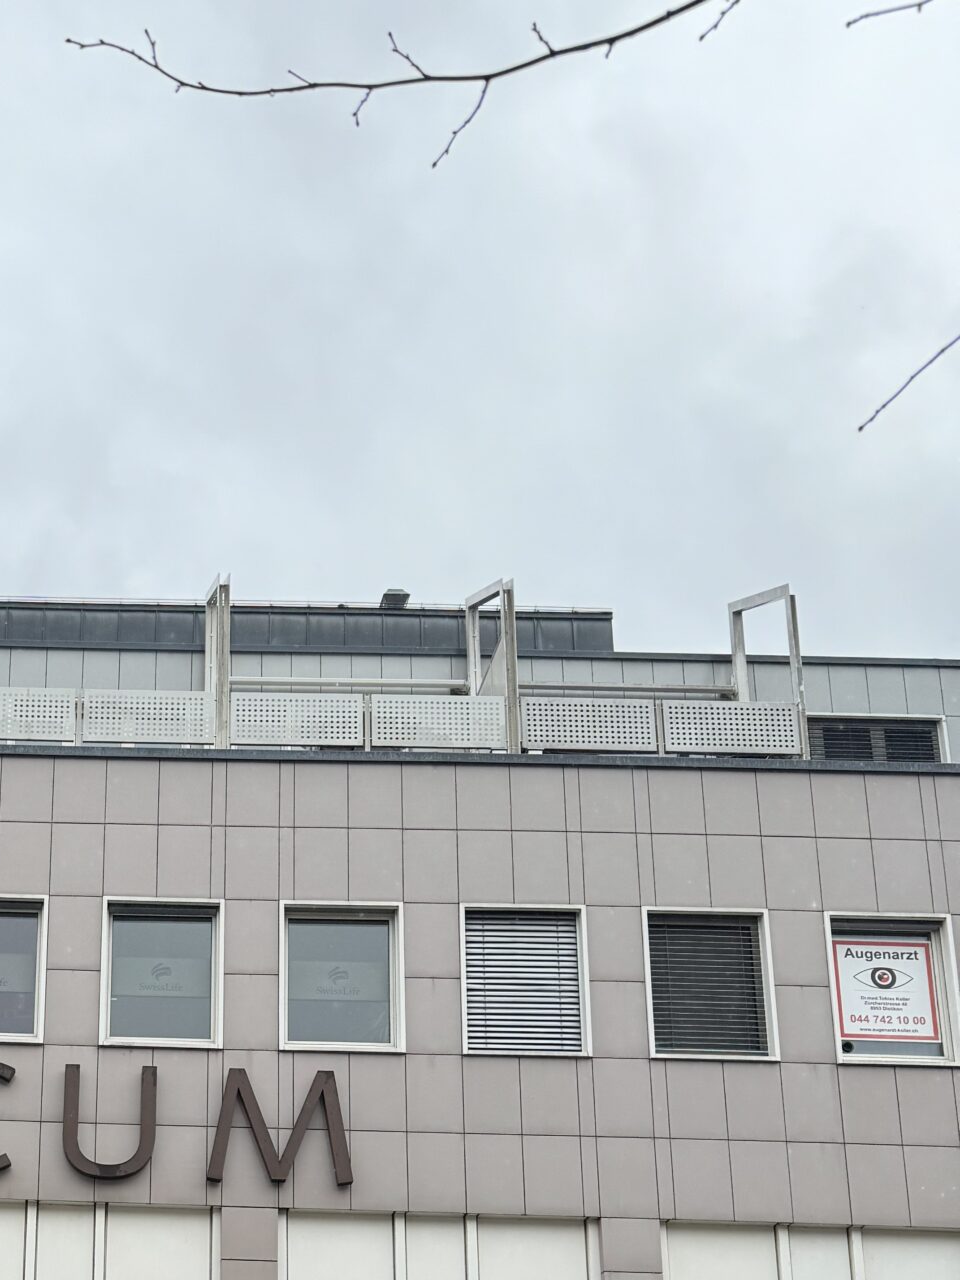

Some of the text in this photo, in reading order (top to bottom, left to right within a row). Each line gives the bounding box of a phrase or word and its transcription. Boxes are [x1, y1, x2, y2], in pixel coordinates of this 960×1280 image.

[844, 948, 920, 962] Augenarzt
[850, 1014, 926, 1025] 044 742 10 00
